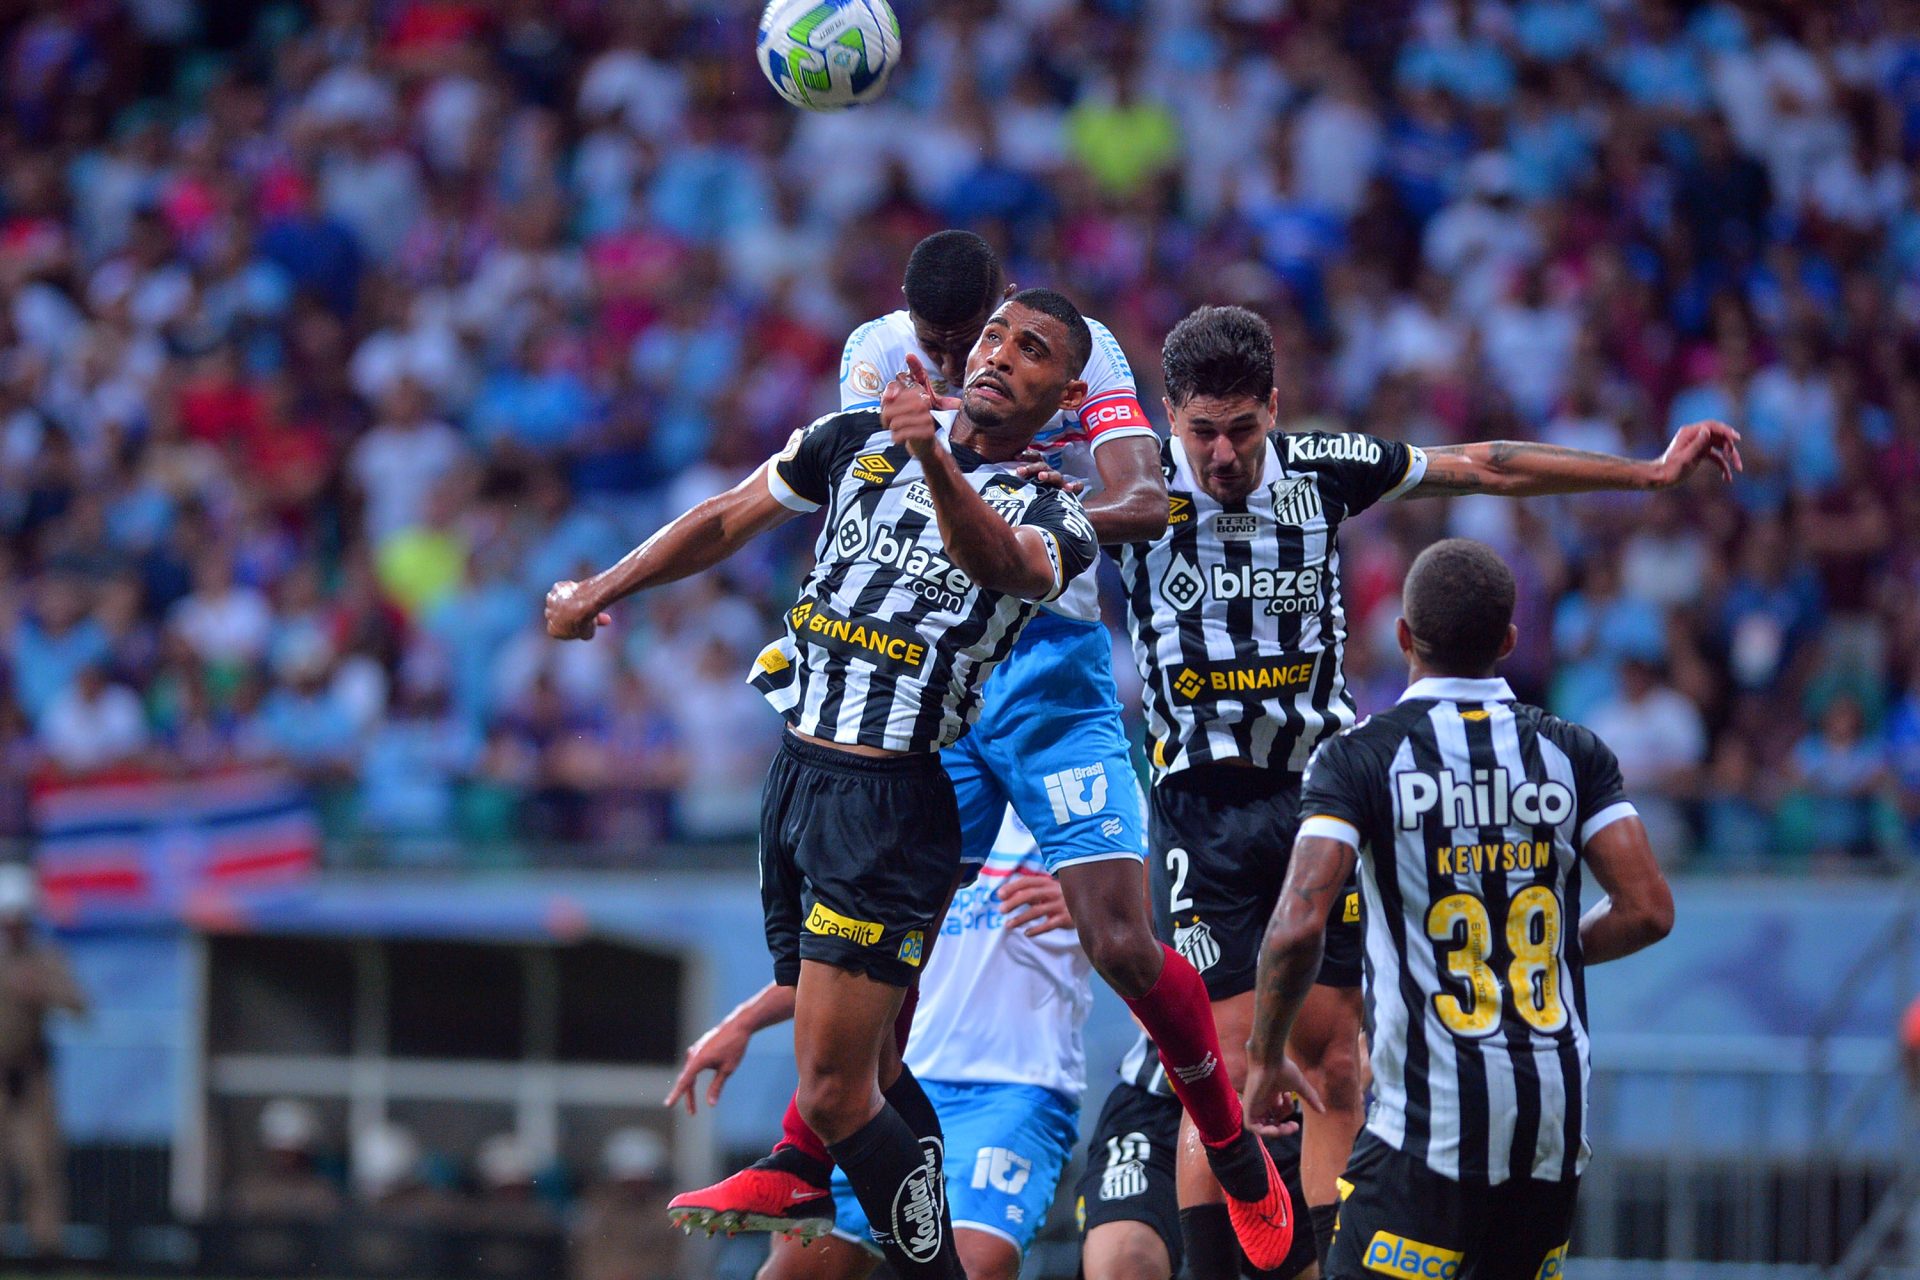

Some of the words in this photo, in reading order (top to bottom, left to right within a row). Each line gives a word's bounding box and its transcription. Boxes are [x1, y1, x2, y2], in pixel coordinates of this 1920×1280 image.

[1095, 336, 1121, 379] Alimentos
[1086, 405, 1132, 430] ECB
[1286, 433, 1381, 464] Kicaldo
[853, 469, 884, 484] umbro
[906, 492, 935, 510] BON
[1168, 513, 1189, 524] bro
[1217, 516, 1257, 525] TEK
[871, 536, 971, 594] blaze
[906, 580, 965, 612] .com
[1213, 566, 1318, 599] blaze
[1265, 595, 1319, 614] .com
[808, 613, 924, 666] BINANCE
[1210, 663, 1312, 691] BINANCE
[1074, 762, 1104, 780] Brasil
[1400, 768, 1574, 830] Philco
[1437, 842, 1551, 875] KEVYSON
[1166, 848, 1193, 913] 2
[811, 908, 875, 944] brasilit
[1428, 887, 1570, 1036] 38
[903, 1177, 938, 1253] Kodilar
